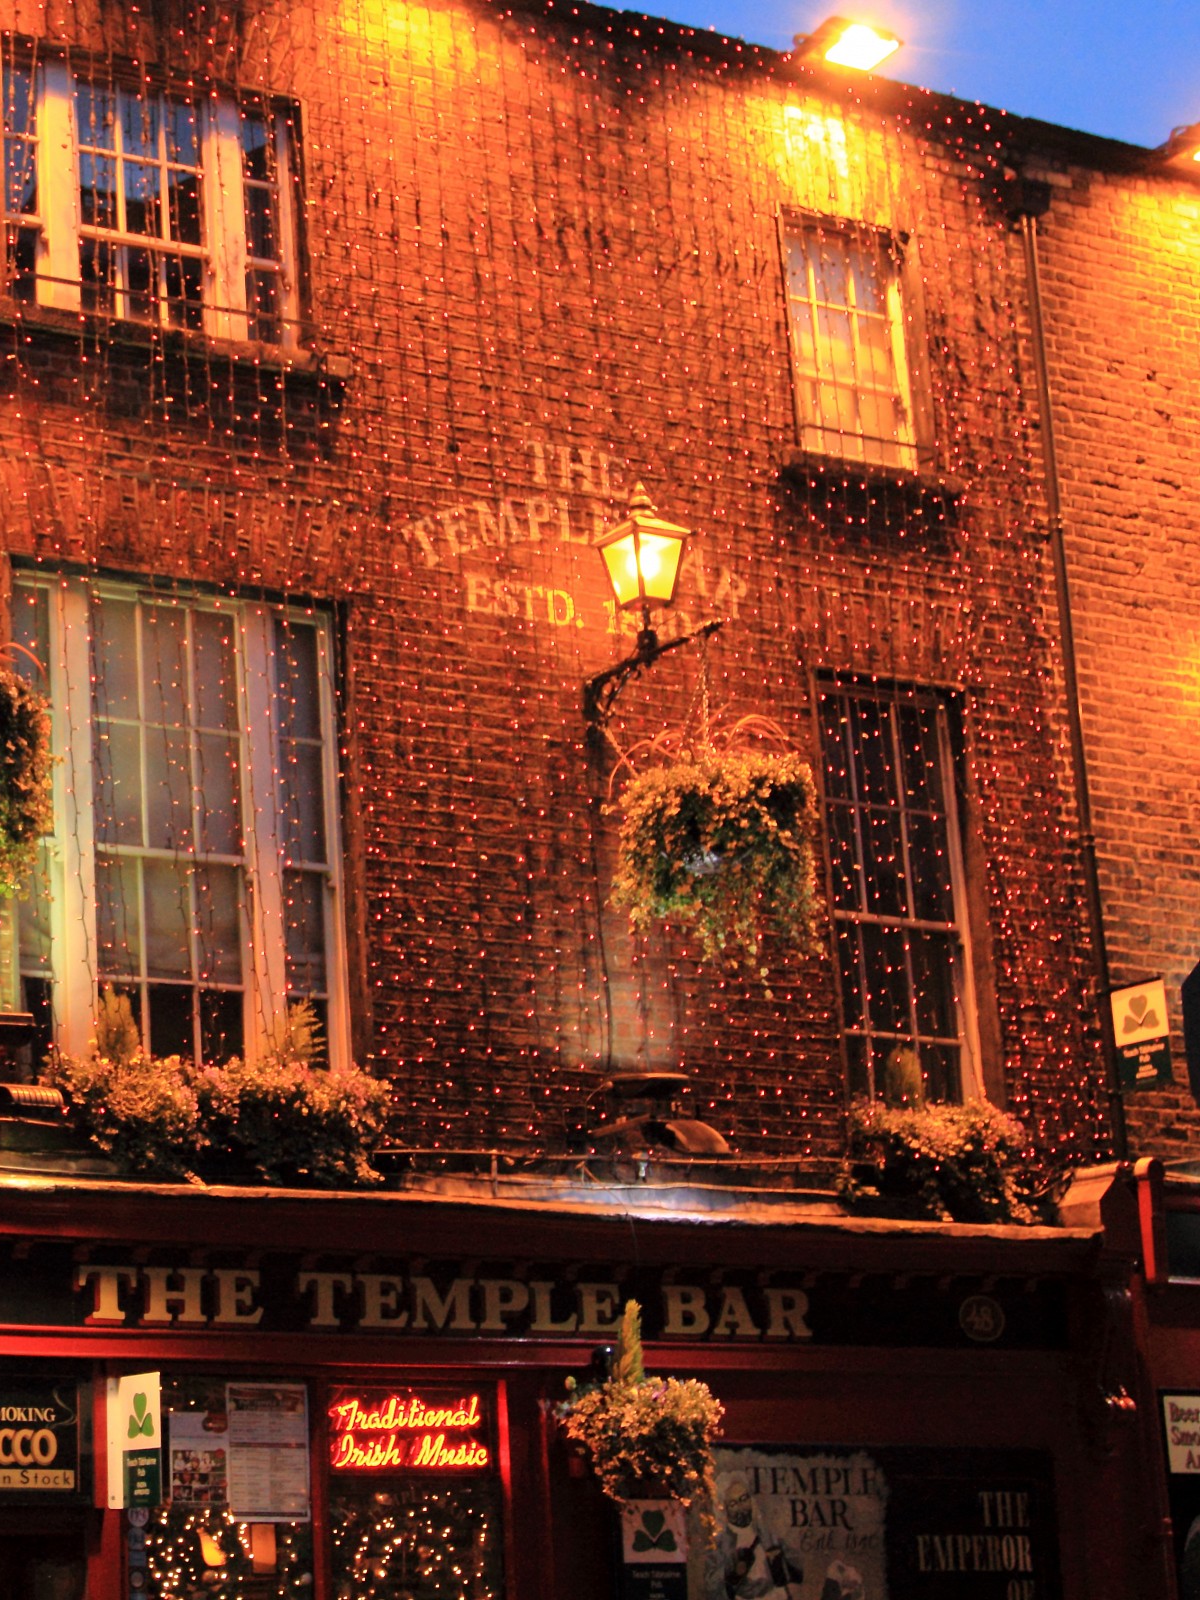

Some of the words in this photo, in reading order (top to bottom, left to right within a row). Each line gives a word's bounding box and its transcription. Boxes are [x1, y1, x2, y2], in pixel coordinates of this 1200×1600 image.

[525, 441, 629, 499] THE
[75, 1264, 265, 1326] THE
[297, 1271, 622, 1334] TEMPLE
[659, 1284, 814, 1339] BAR
[336, 1397, 480, 1431] Traditional
[335, 1433, 401, 1467] Irish
[413, 1433, 488, 1467] Music
[19, 1469, 72, 1486] Stock
[747, 1466, 883, 1496] TEMPLE
[790, 1499, 853, 1530] BAR
[978, 1490, 1030, 1528] THE
[915, 1534, 1034, 1572] EMPEROR
